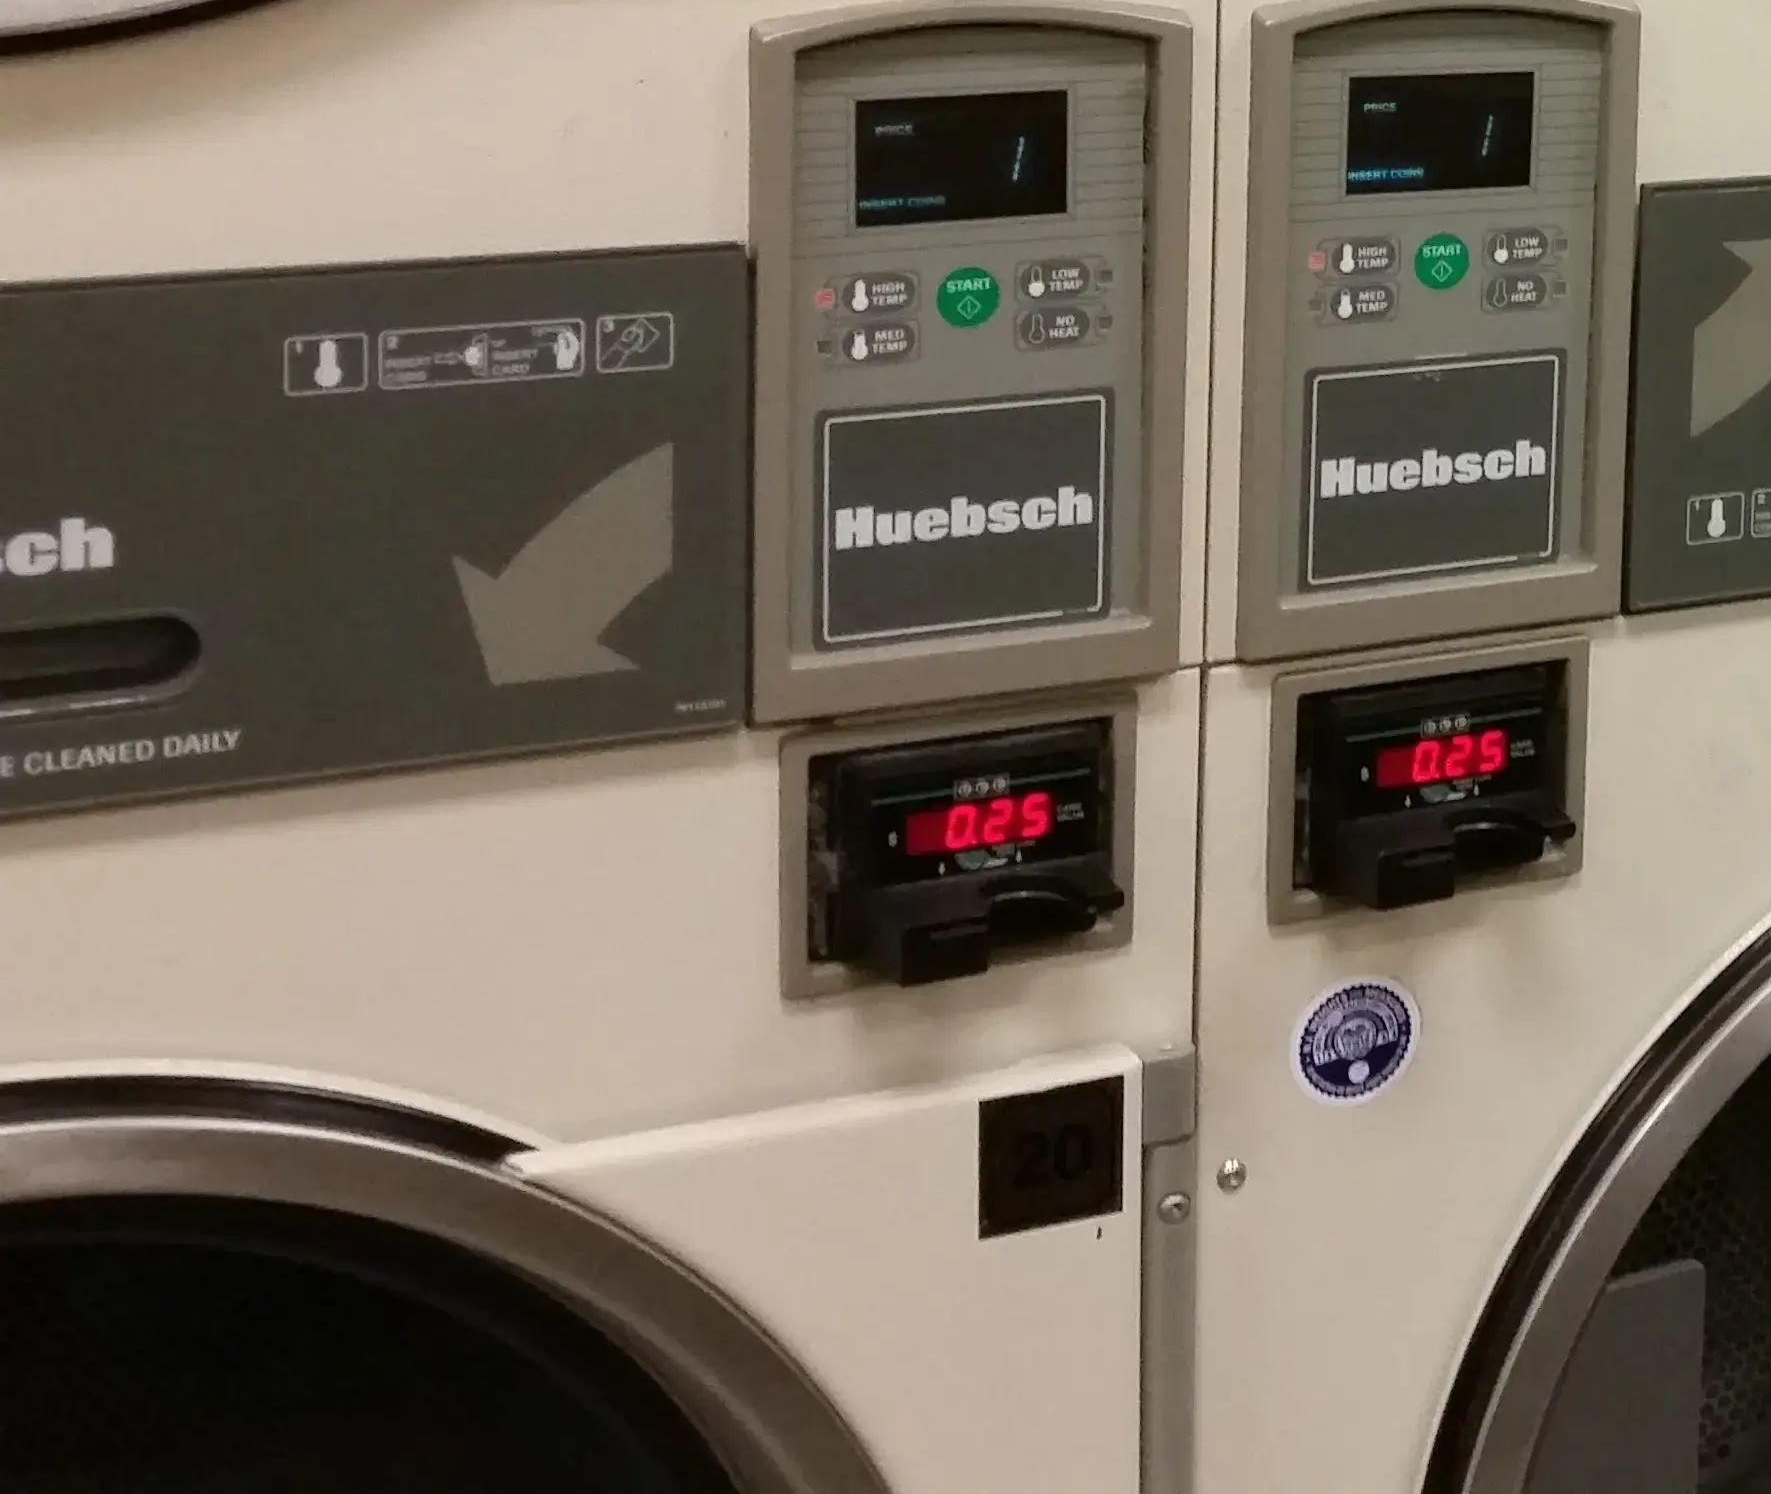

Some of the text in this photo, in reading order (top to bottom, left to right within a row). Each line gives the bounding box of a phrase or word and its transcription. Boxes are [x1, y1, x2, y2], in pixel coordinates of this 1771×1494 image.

[1363, 101, 1398, 114] PRICE
[1482, 114, 1494, 156] 1
[1011, 136, 1025, 182] 1
[1514, 237, 1539, 249] LOW
[1358, 246, 1388, 259] HIGH
[1422, 244, 1461, 257] START
[1512, 247, 1543, 260] TEMP
[1358, 257, 1389, 269] TEMP
[1051, 268, 1081, 281] LOW
[872, 281, 906, 295] HIGH
[946, 276, 992, 294] START
[1049, 278, 1084, 292] TEMP
[1516, 281, 1534, 292] NO
[872, 293, 908, 307] TEMP
[1357, 290, 1385, 302] MED
[1511, 291, 1538, 303] HEAT
[1355, 300, 1388, 313] TEMP
[1055, 314, 1075, 328] NO
[874, 328, 905, 342] MED
[1049, 325, 1081, 339] HEAT
[872, 340, 907, 354] TEMP
[1319, 439, 1547, 501] Huebsch
[835, 486, 1093, 550] Huebsch
[23, 738, 156, 776] CLEANED
[162, 727, 242, 758] DAILY
[1411, 728, 1506, 784] 0.25
[944, 791, 1051, 850] 0.25
[1011, 1122, 1093, 1188] 20
